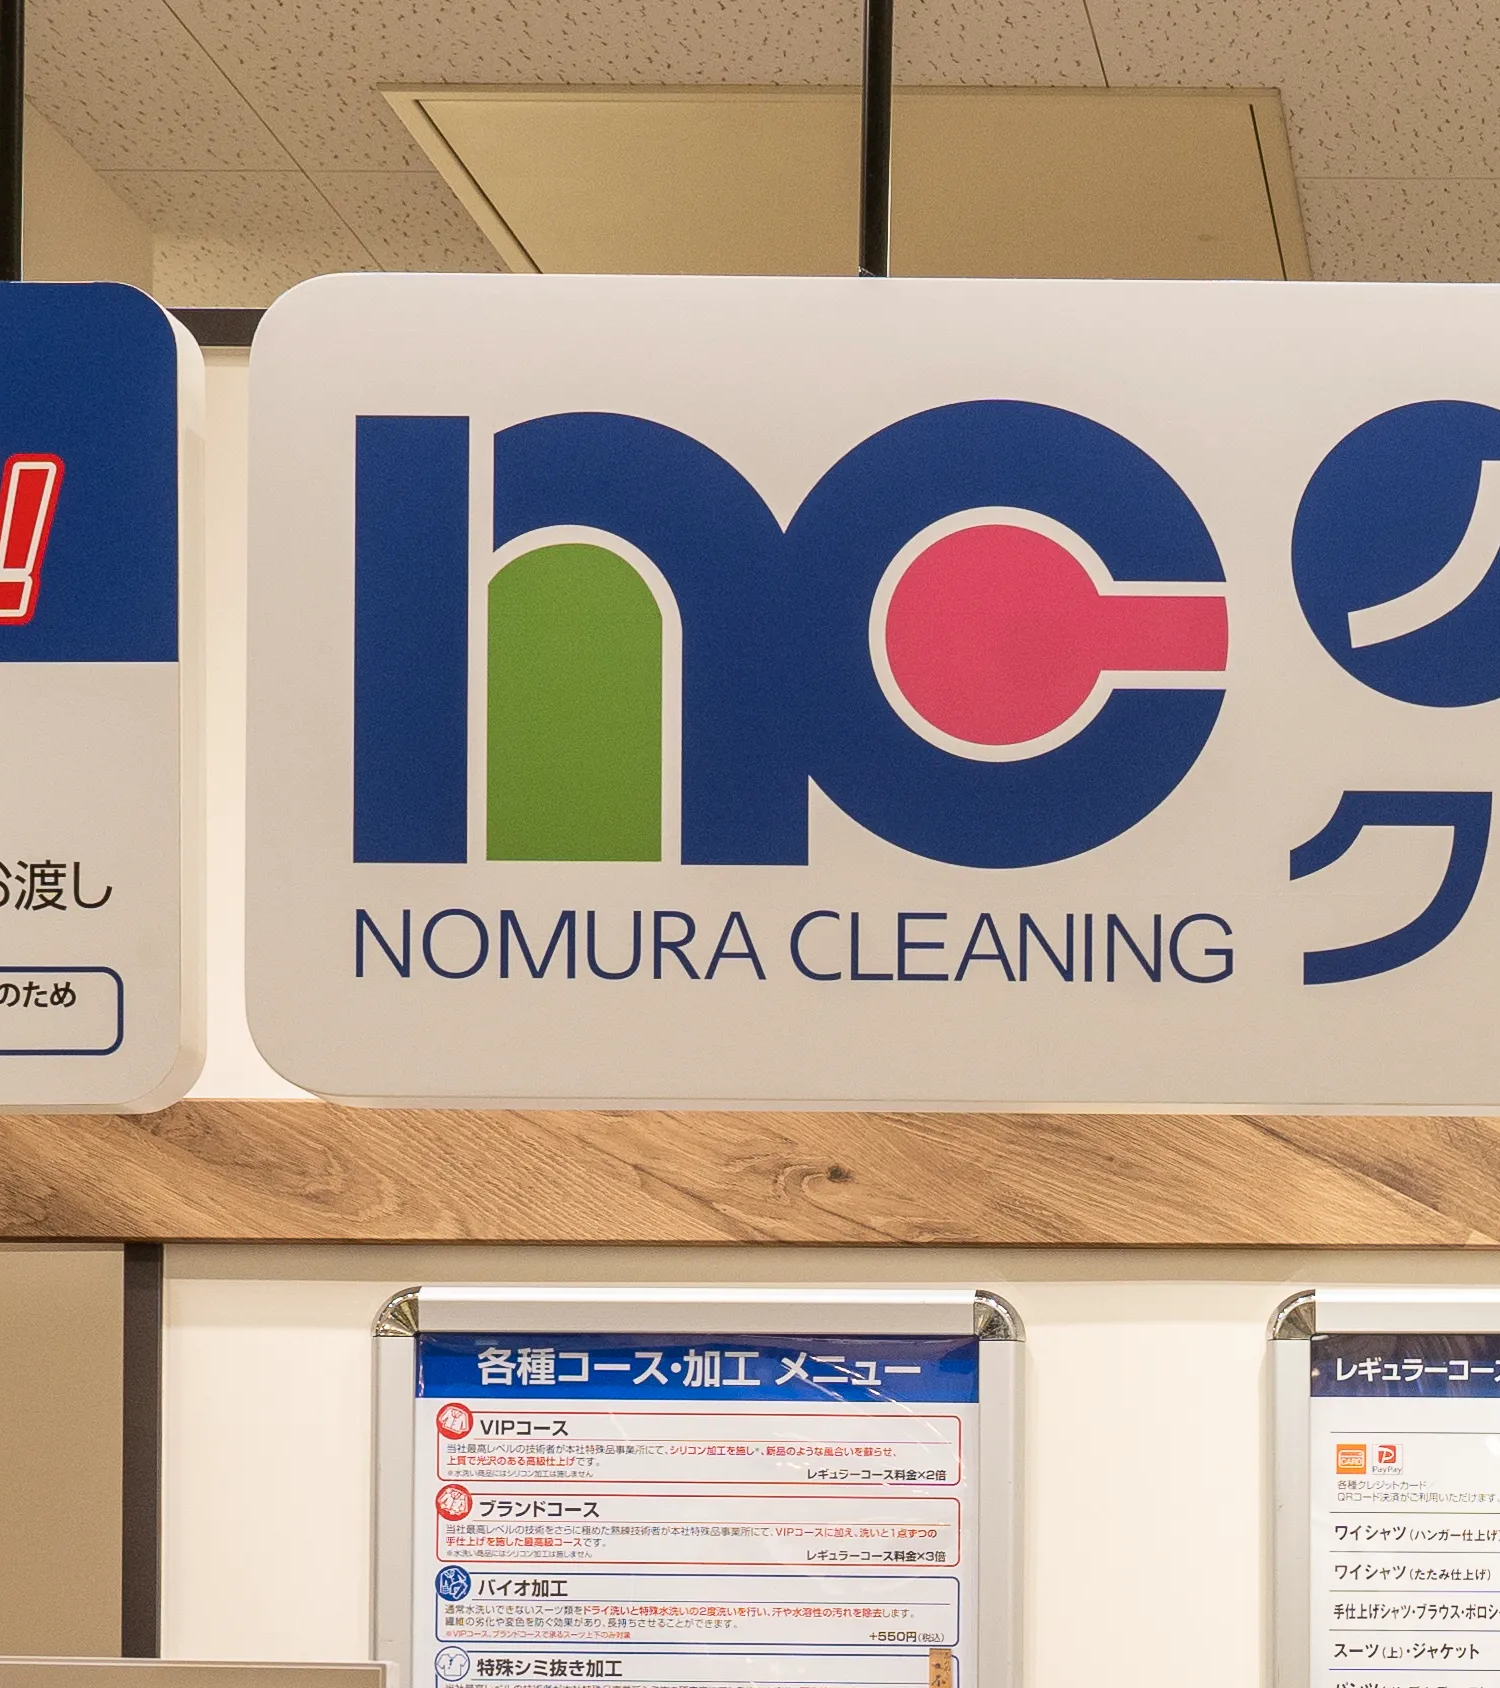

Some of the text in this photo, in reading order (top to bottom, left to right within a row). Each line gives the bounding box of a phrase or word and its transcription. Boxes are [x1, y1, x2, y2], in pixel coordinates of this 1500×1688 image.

[353, 909, 1236, 985] NOMURA CLEANING
[776, 1352, 921, 1386] メニュー
[480, 1420, 568, 1436] VIPコース
[480, 1501, 600, 1517] ブランドコース
[478, 1580, 568, 1597] バイオ加工
[477, 1660, 622, 1677] 特殊シミ抜き加工
